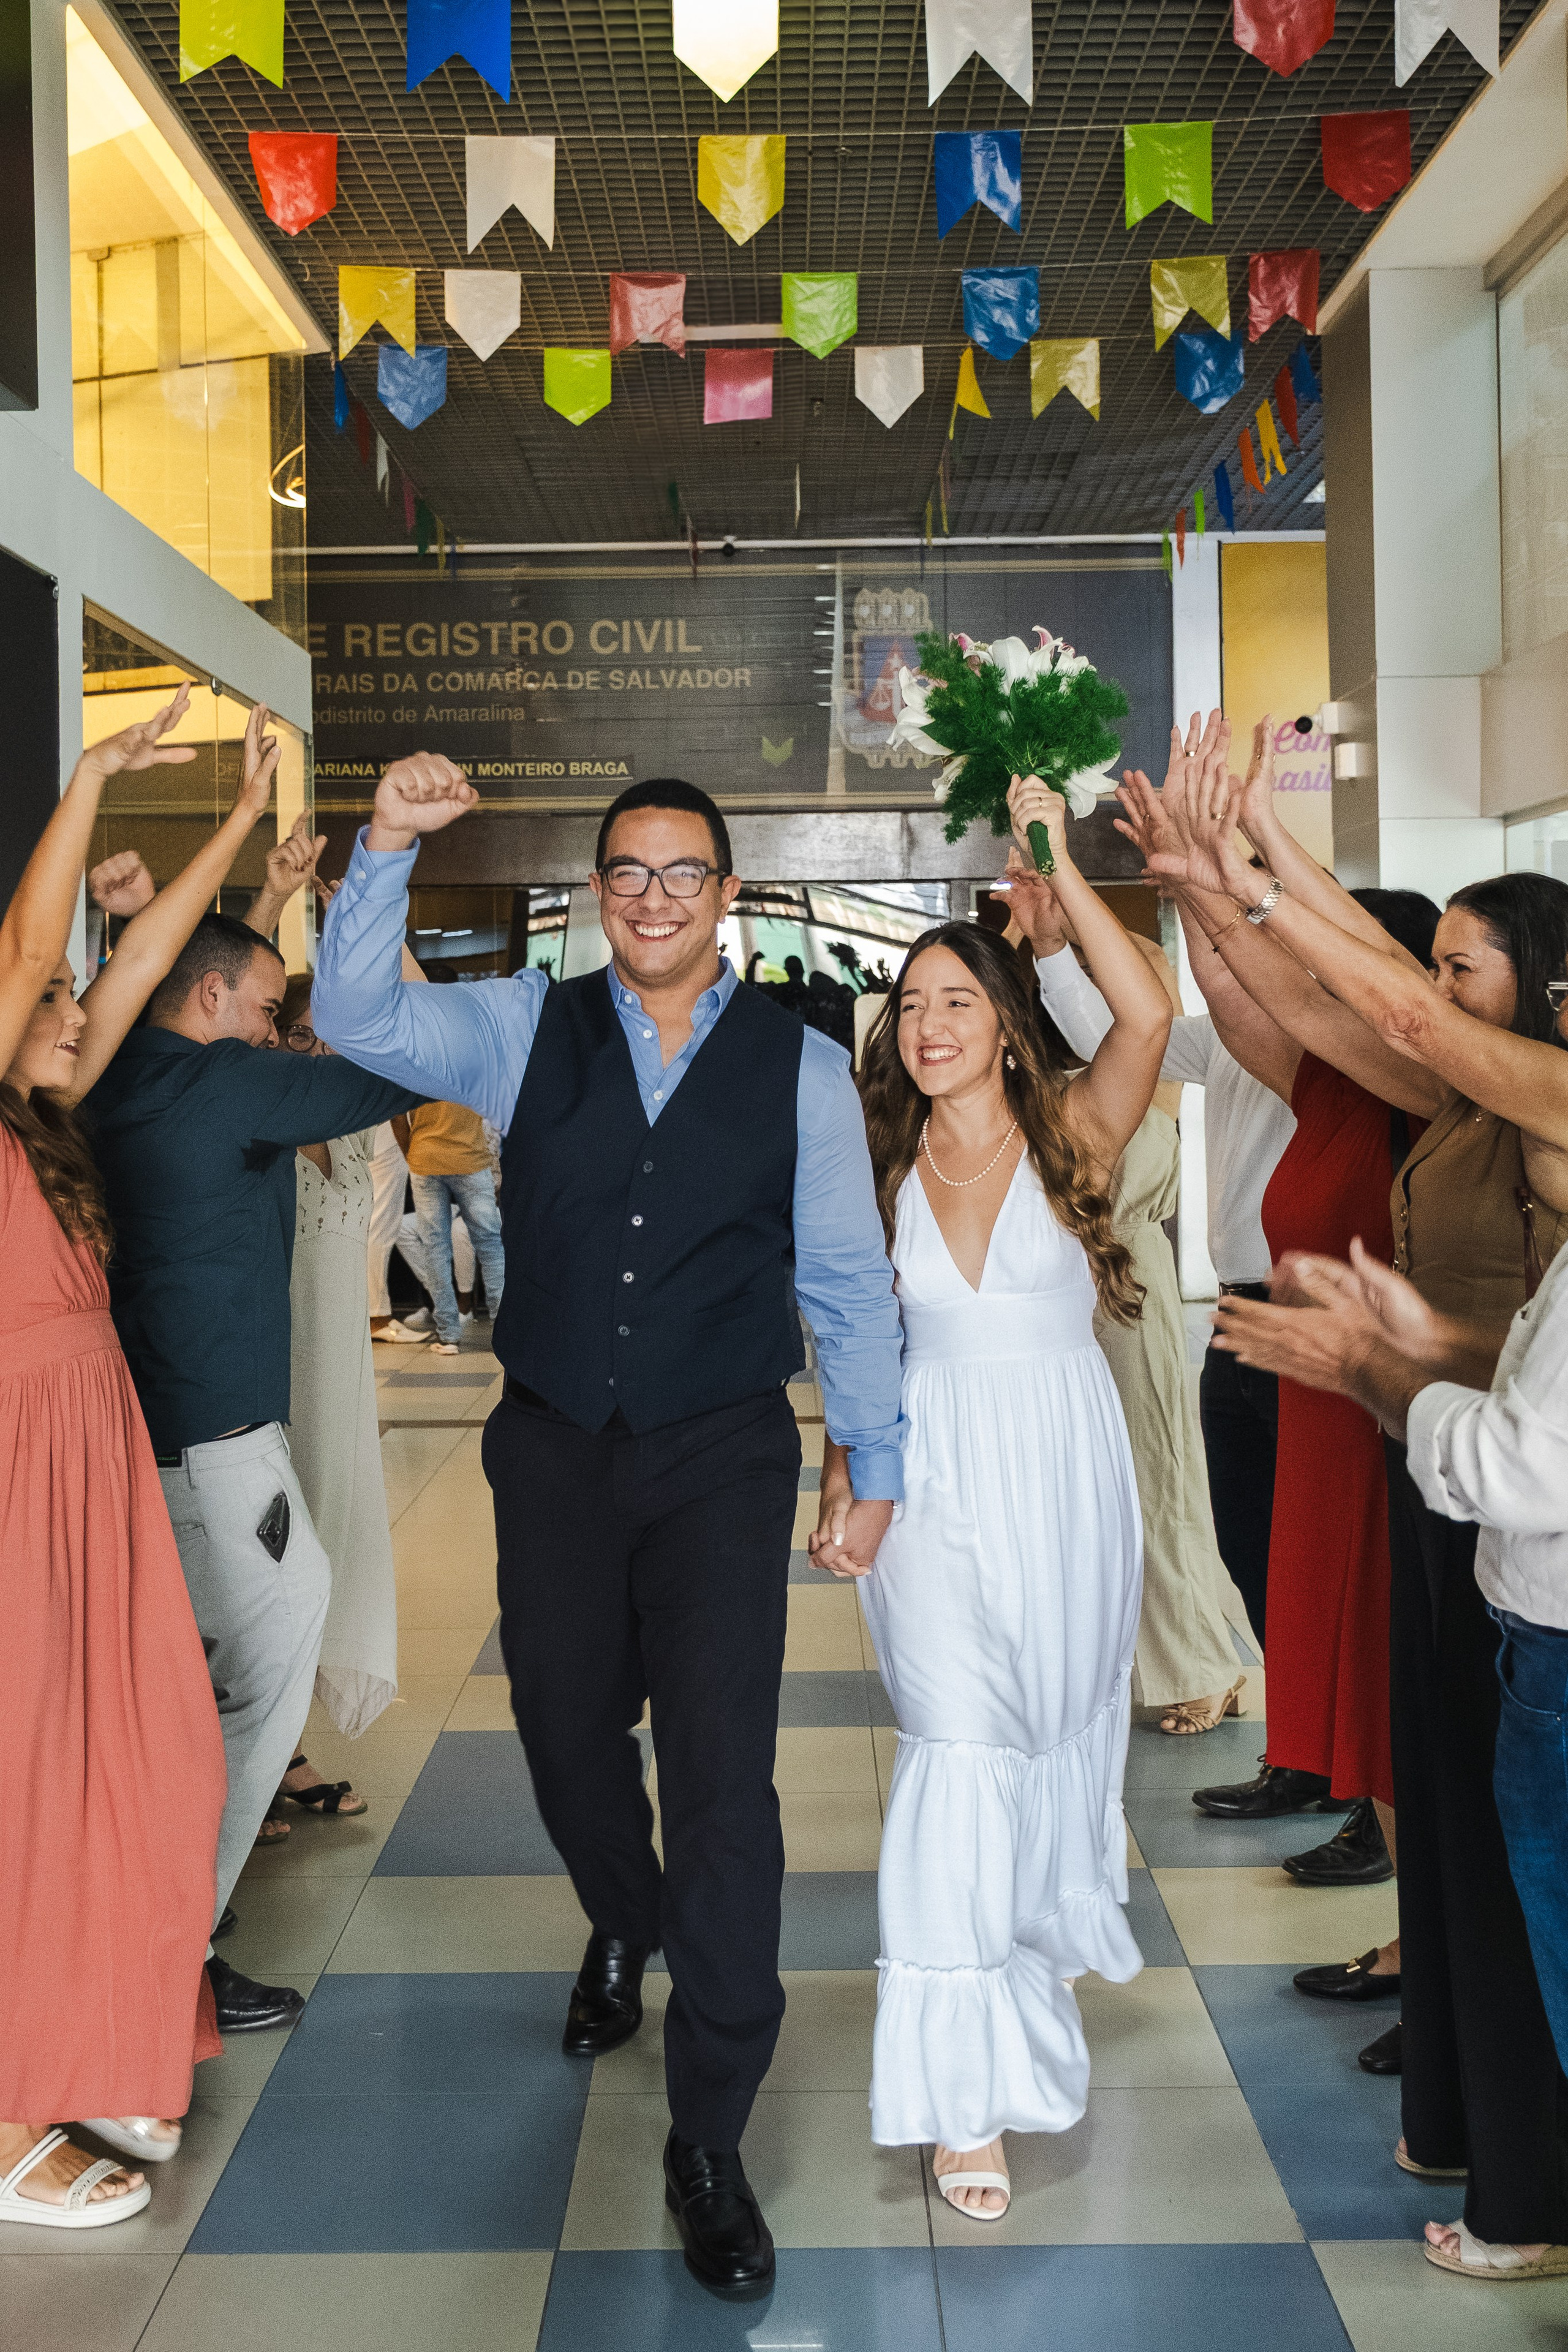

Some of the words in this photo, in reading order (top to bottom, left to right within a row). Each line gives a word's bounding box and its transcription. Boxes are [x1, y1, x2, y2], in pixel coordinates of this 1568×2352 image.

[343, 619, 575, 658] REGISTRO
[589, 619, 703, 654] CIVIL
[382, 672, 419, 693] DA
[426, 669, 559, 692] COMARCA
[565, 669, 602, 691] DE
[608, 667, 753, 691] SALVADOR
[391, 704, 418, 724] de
[423, 704, 526, 723] Amaralina
[313, 763, 375, 777] ARIANA
[477, 761, 565, 777] MONTEIRO
[568, 761, 629, 776] BRAGA
[1272, 763, 1331, 791] asi
